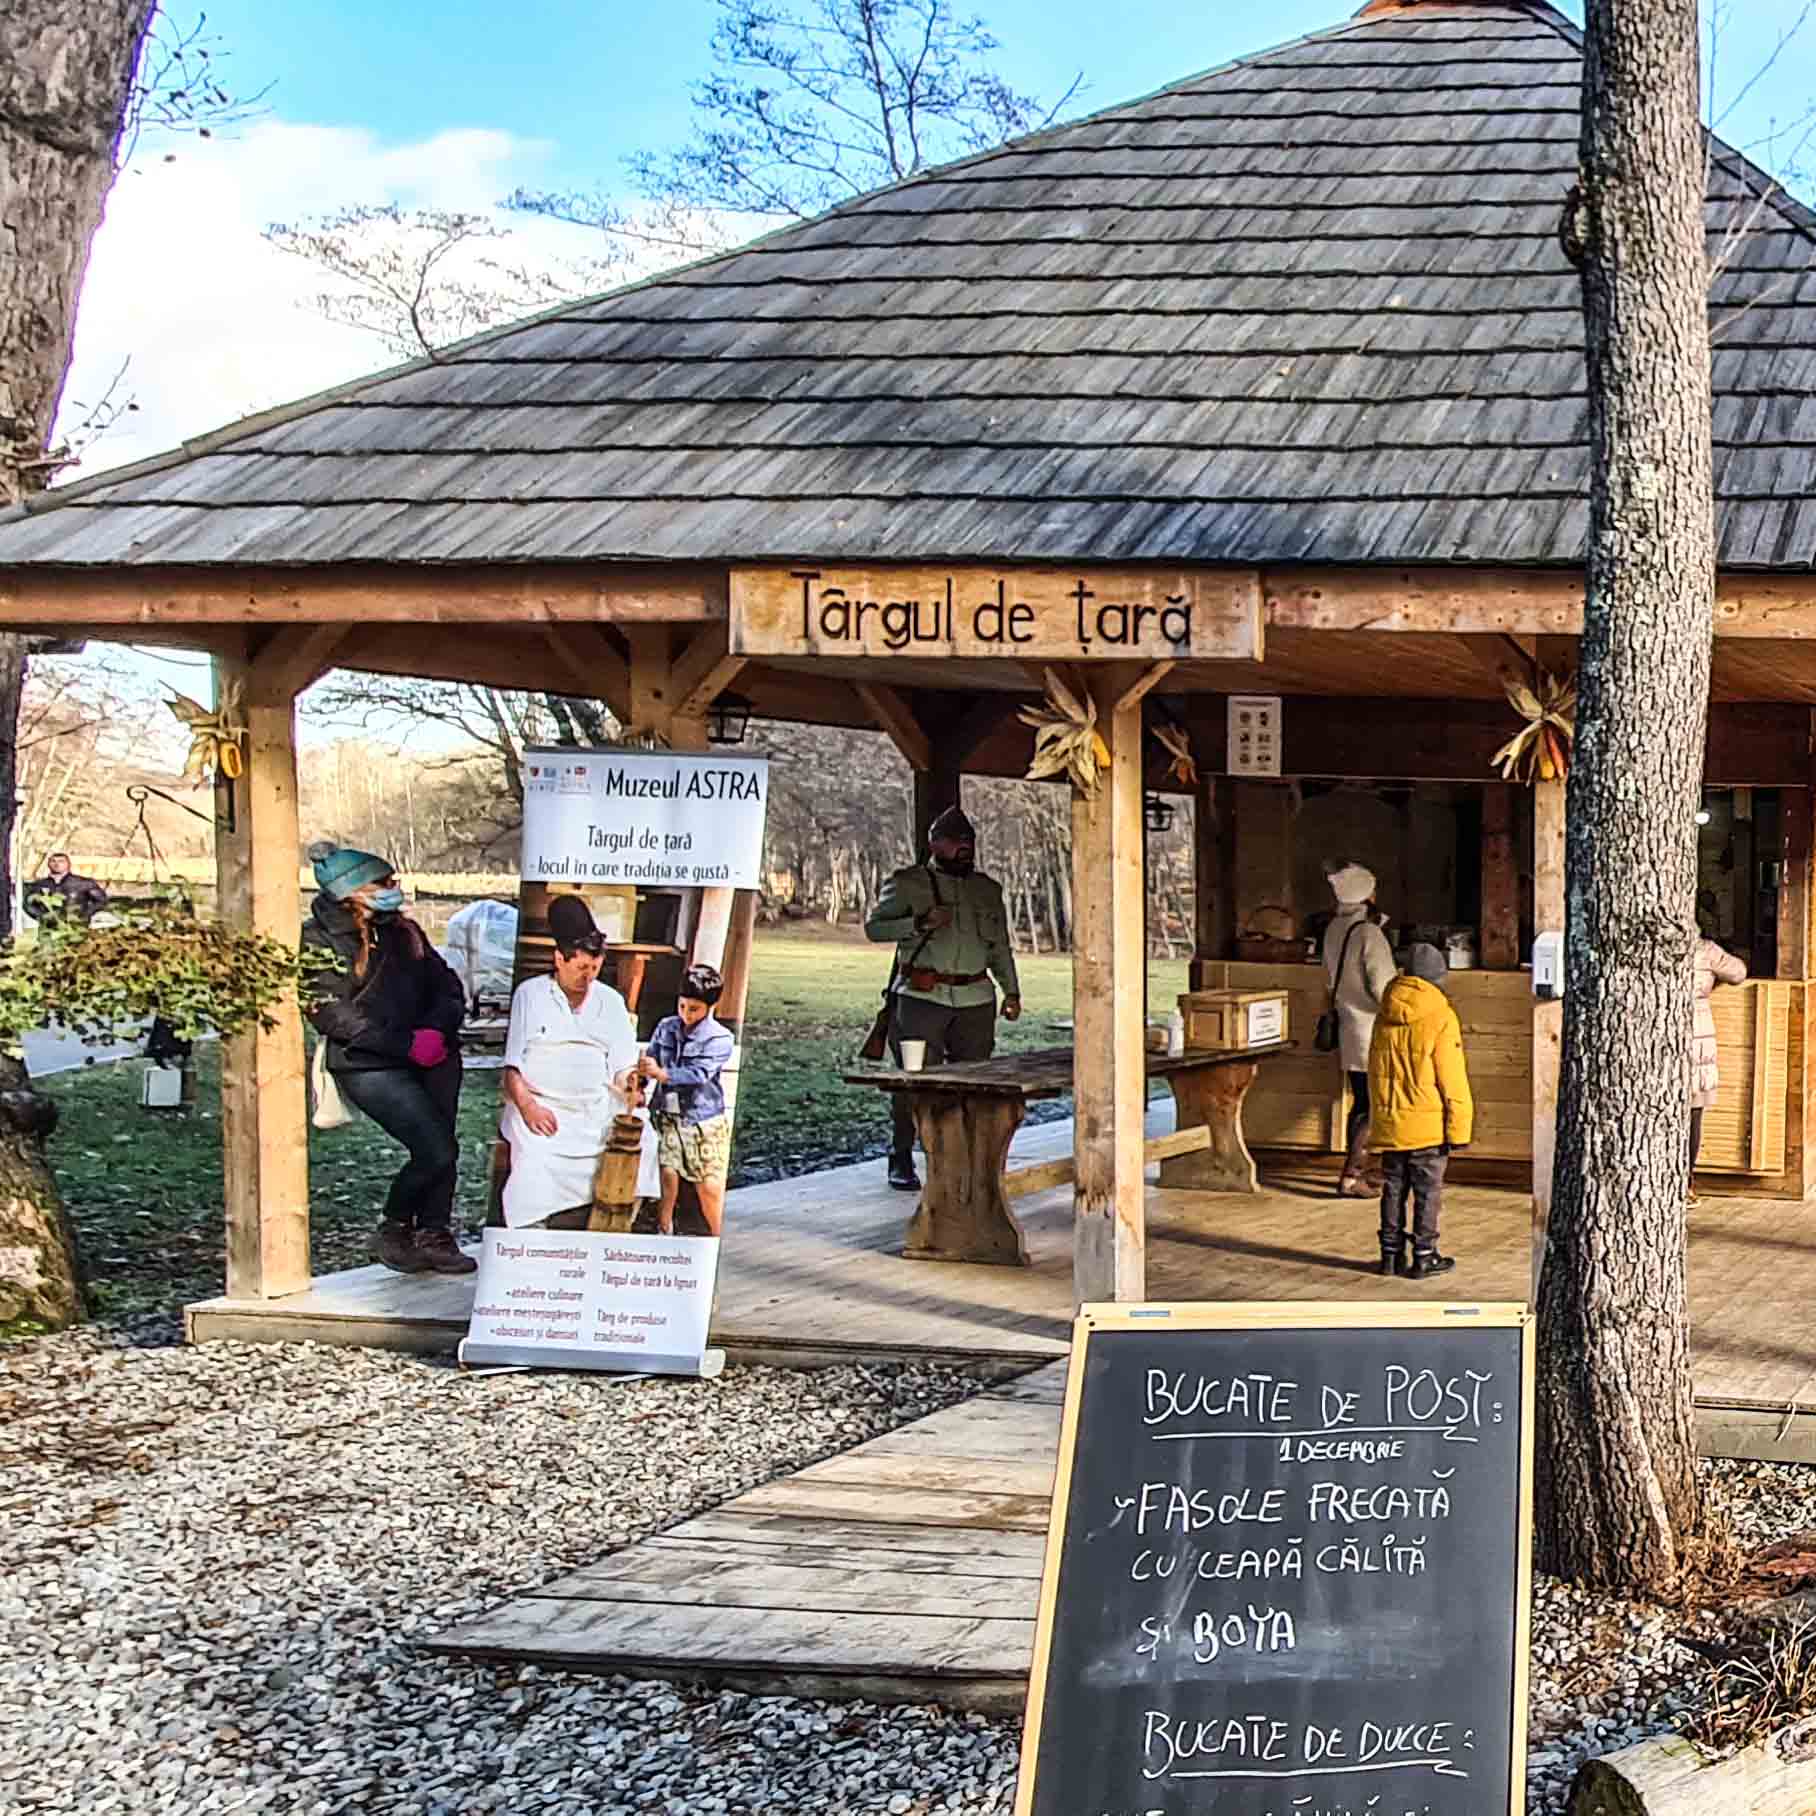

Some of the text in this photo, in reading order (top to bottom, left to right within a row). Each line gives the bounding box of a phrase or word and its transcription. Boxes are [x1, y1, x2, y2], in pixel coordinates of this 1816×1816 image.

[790, 571, 1192, 655] Târgul de țară
[605, 767, 681, 799] Muzeul
[686, 769, 761, 801] ASTRA
[588, 825, 692, 854] Târgul de țară
[538, 856, 569, 876] locul
[592, 862, 619, 878] care
[624, 858, 672, 882] tradiția
[675, 865, 689, 881] se
[692, 863, 729, 883] gustă
[1143, 1364, 1503, 1427] BUCATE DE POST:
[1308, 1467, 1456, 1523] FRECATĂ
[1131, 1549, 1177, 1581] CU
[1197, 1537, 1302, 1579] CEAPĂ
[1141, 1710, 1289, 1779] BUCATE
[1303, 1723, 1346, 1763] DE
